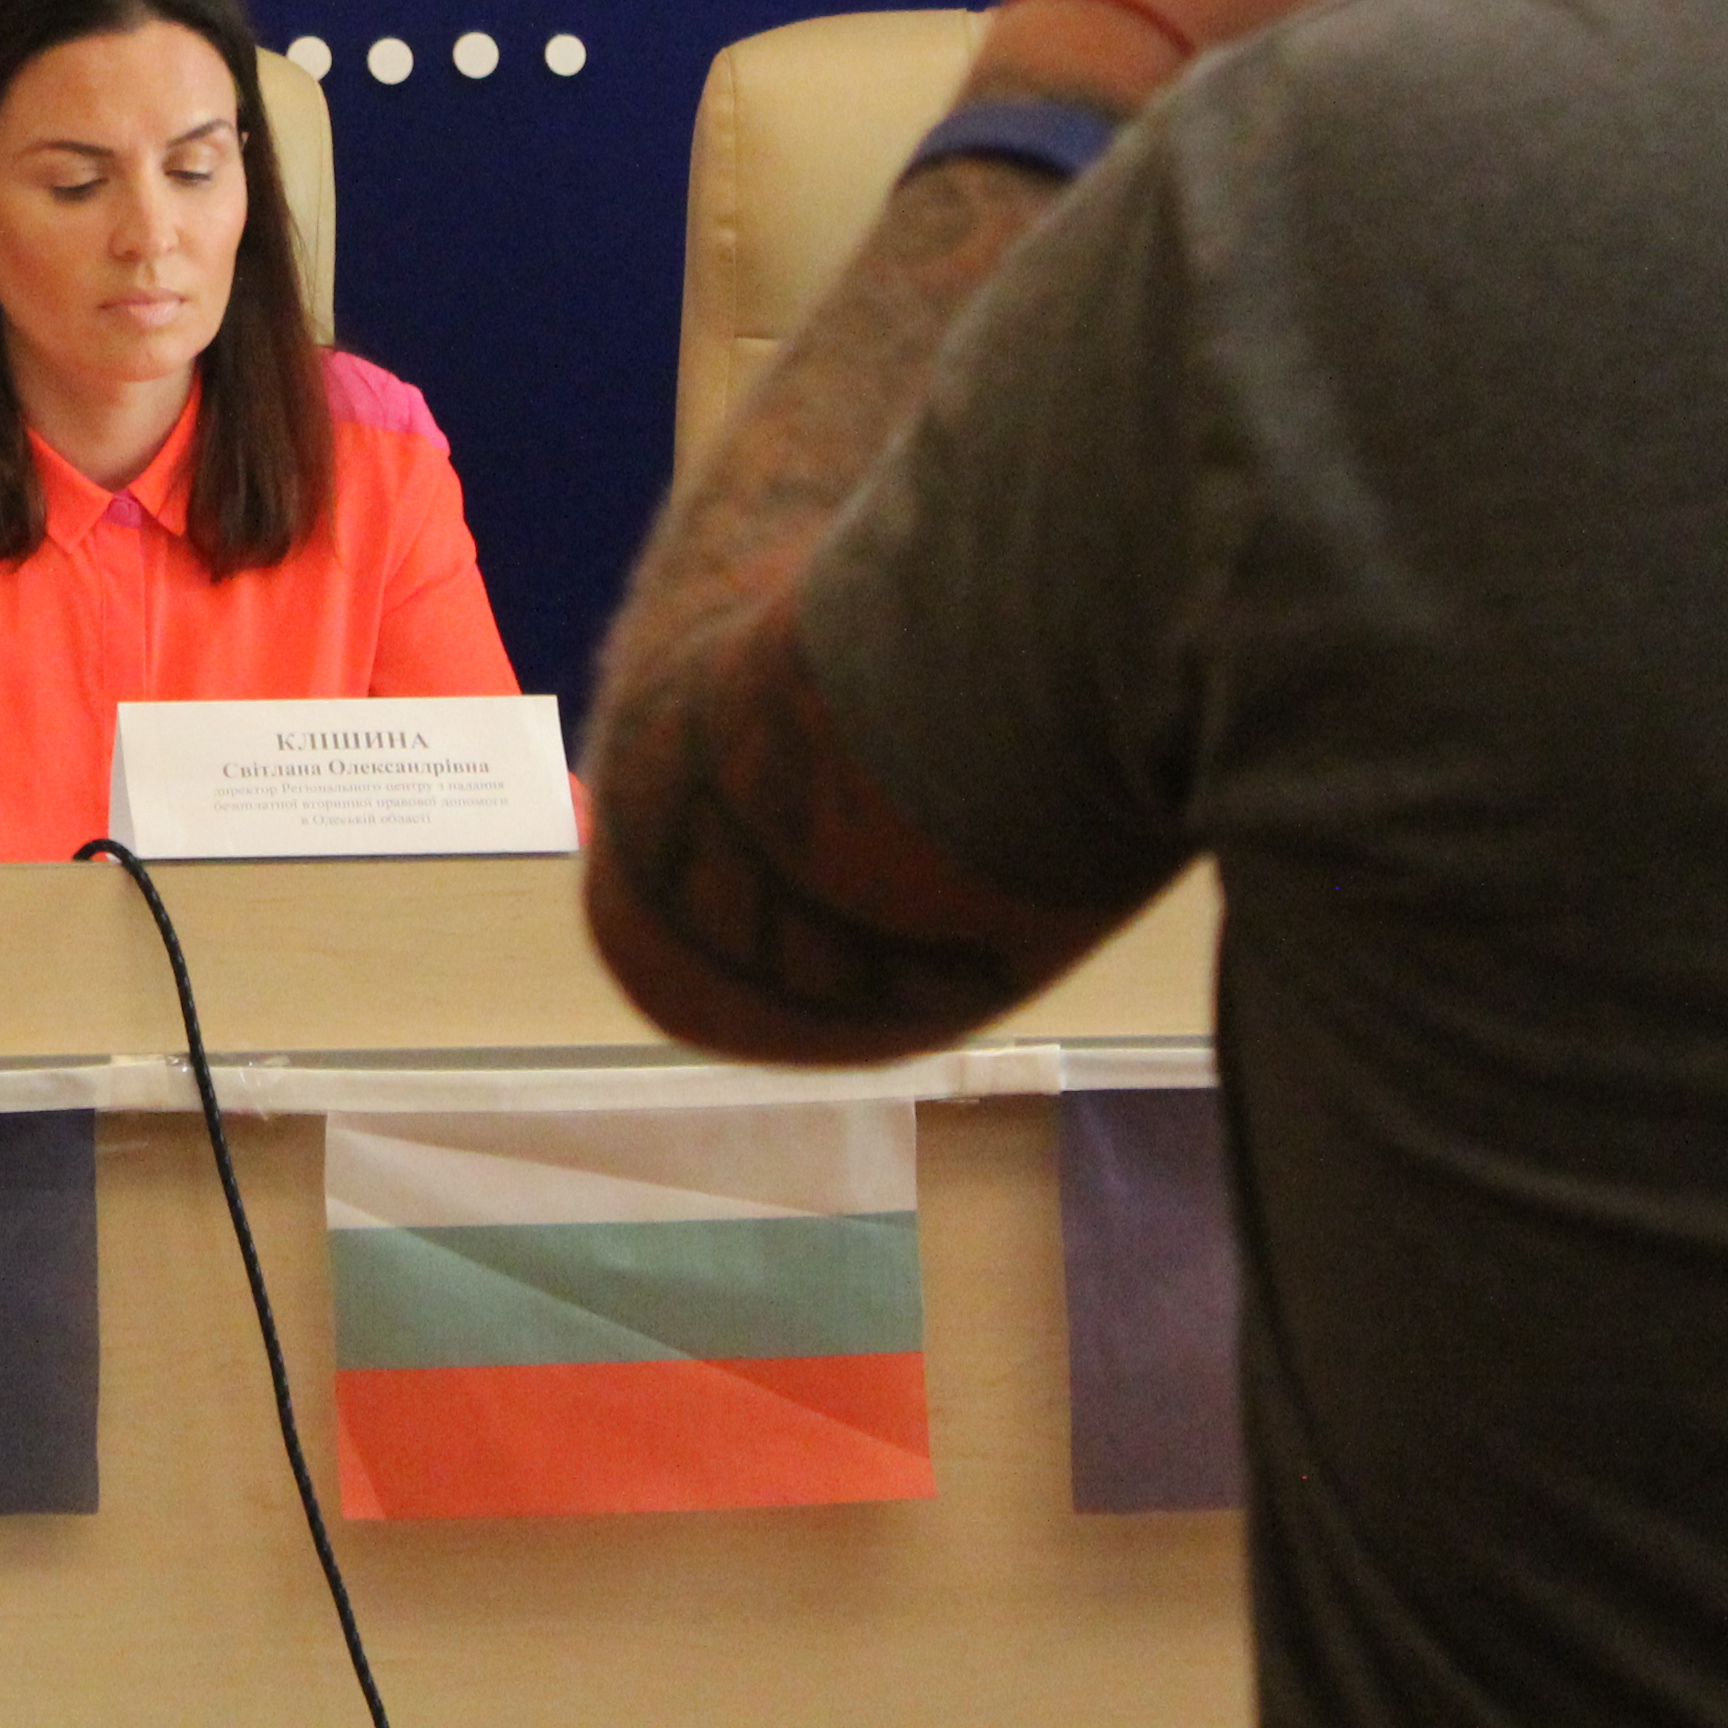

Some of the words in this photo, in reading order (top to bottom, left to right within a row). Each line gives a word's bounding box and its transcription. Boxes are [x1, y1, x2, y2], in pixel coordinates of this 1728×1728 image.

[276, 731, 430, 751] КЛІШИНА
[222, 760, 322, 778] Світлана
[328, 758, 490, 778] Олександрівна
